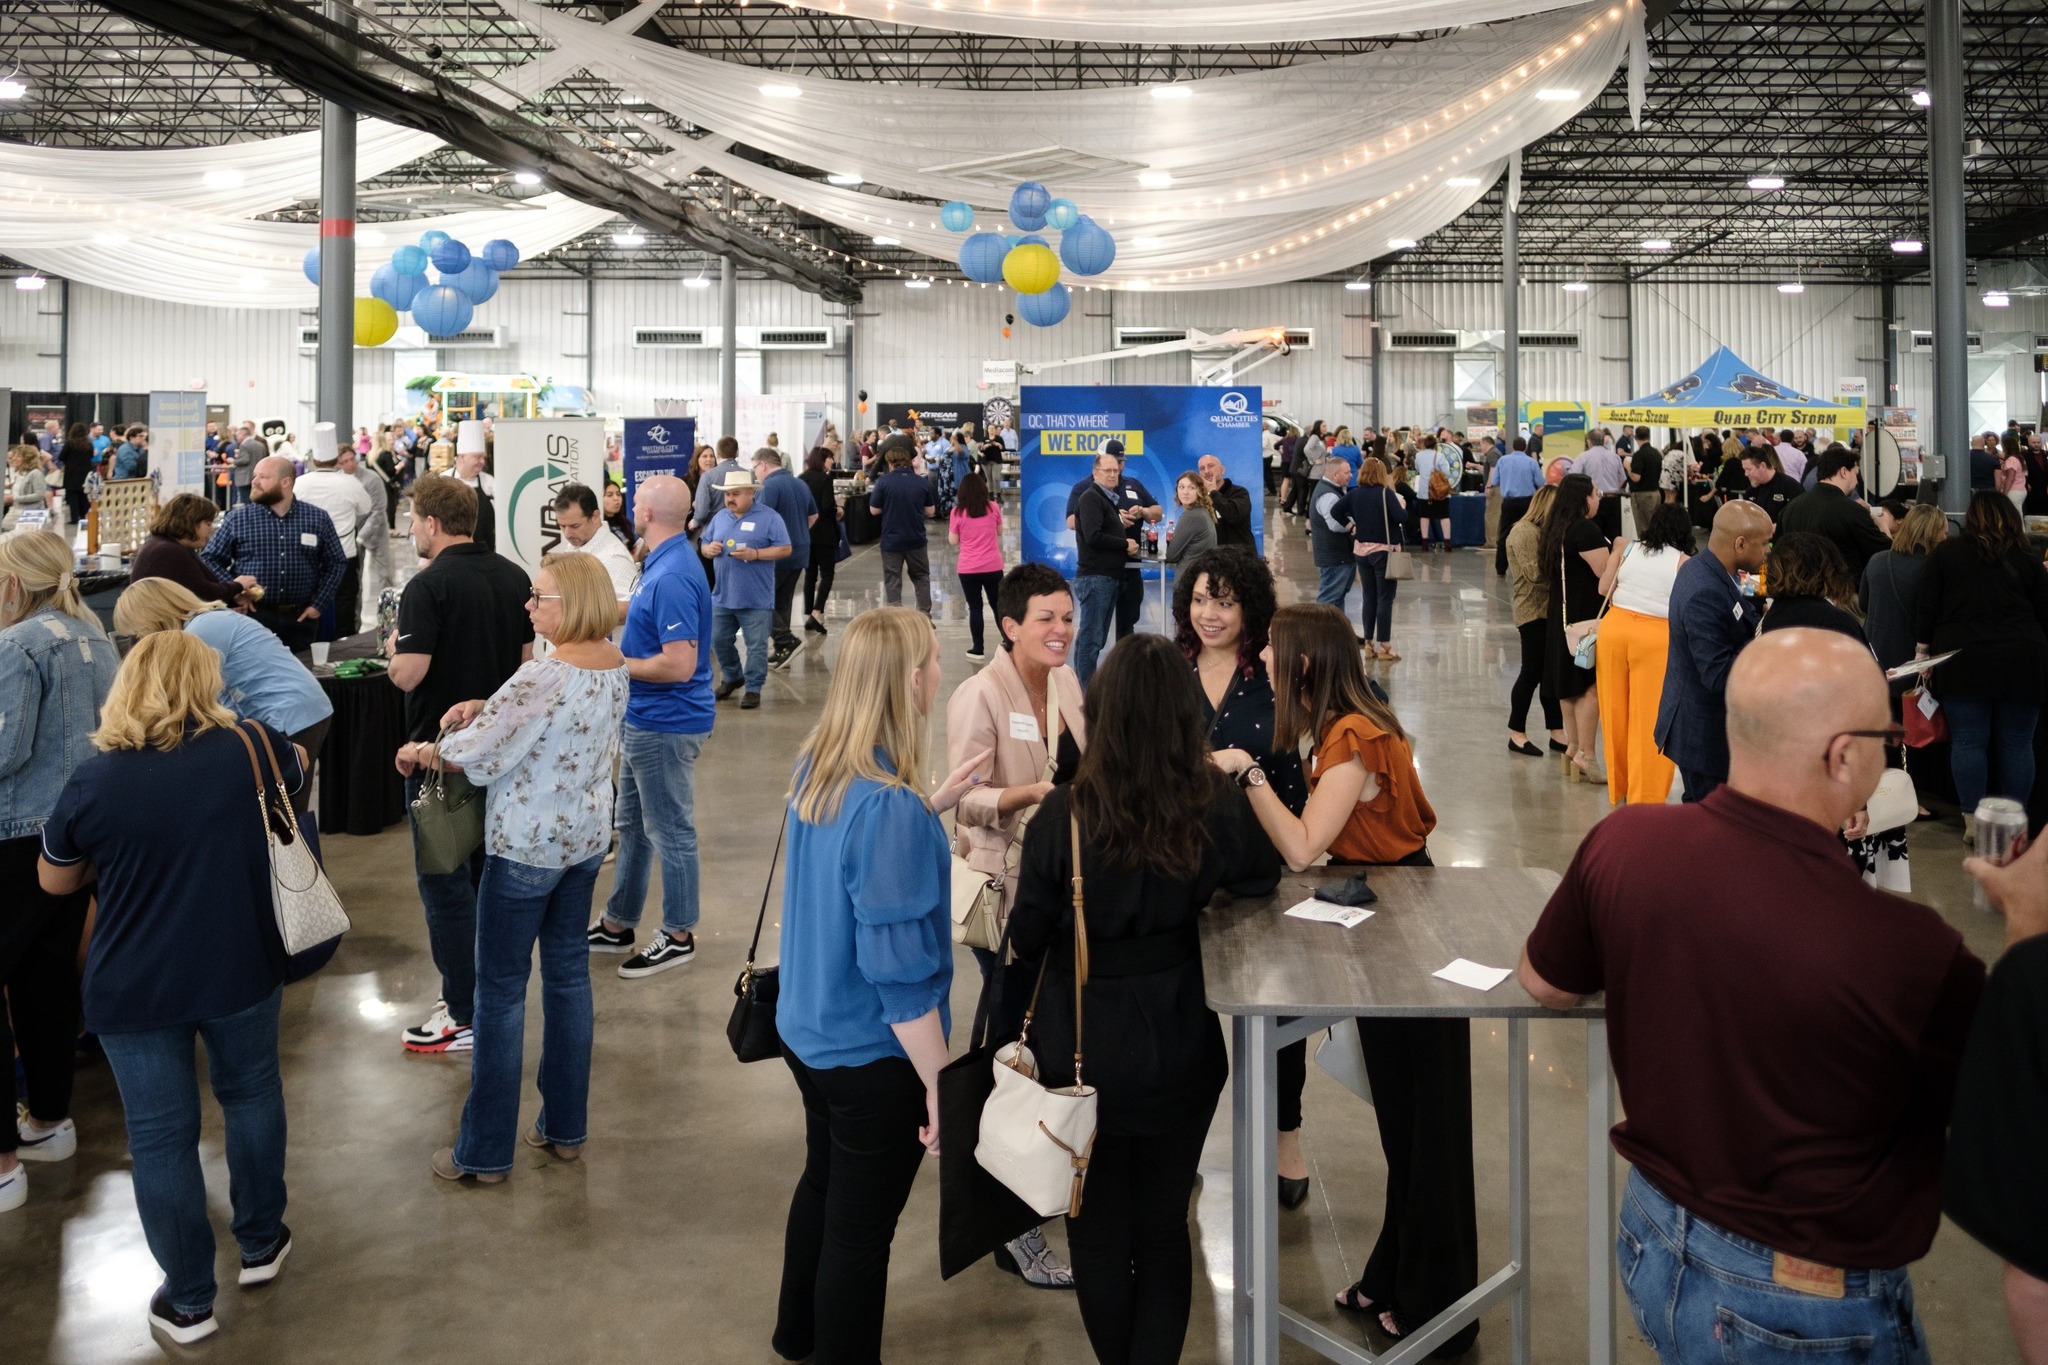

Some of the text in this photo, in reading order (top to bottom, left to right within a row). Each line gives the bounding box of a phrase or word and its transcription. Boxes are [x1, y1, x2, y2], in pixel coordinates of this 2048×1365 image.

[1028, 414, 1109, 429] QC, THAT'S WHERE
[1210, 414, 1258, 423] QUAD CITIES
[1645, 409, 1669, 424] STORM
[1713, 409, 1837, 425] QUAD CITY STORM
[1047, 433, 1073, 452] WE
[570, 438, 579, 482] ATION
